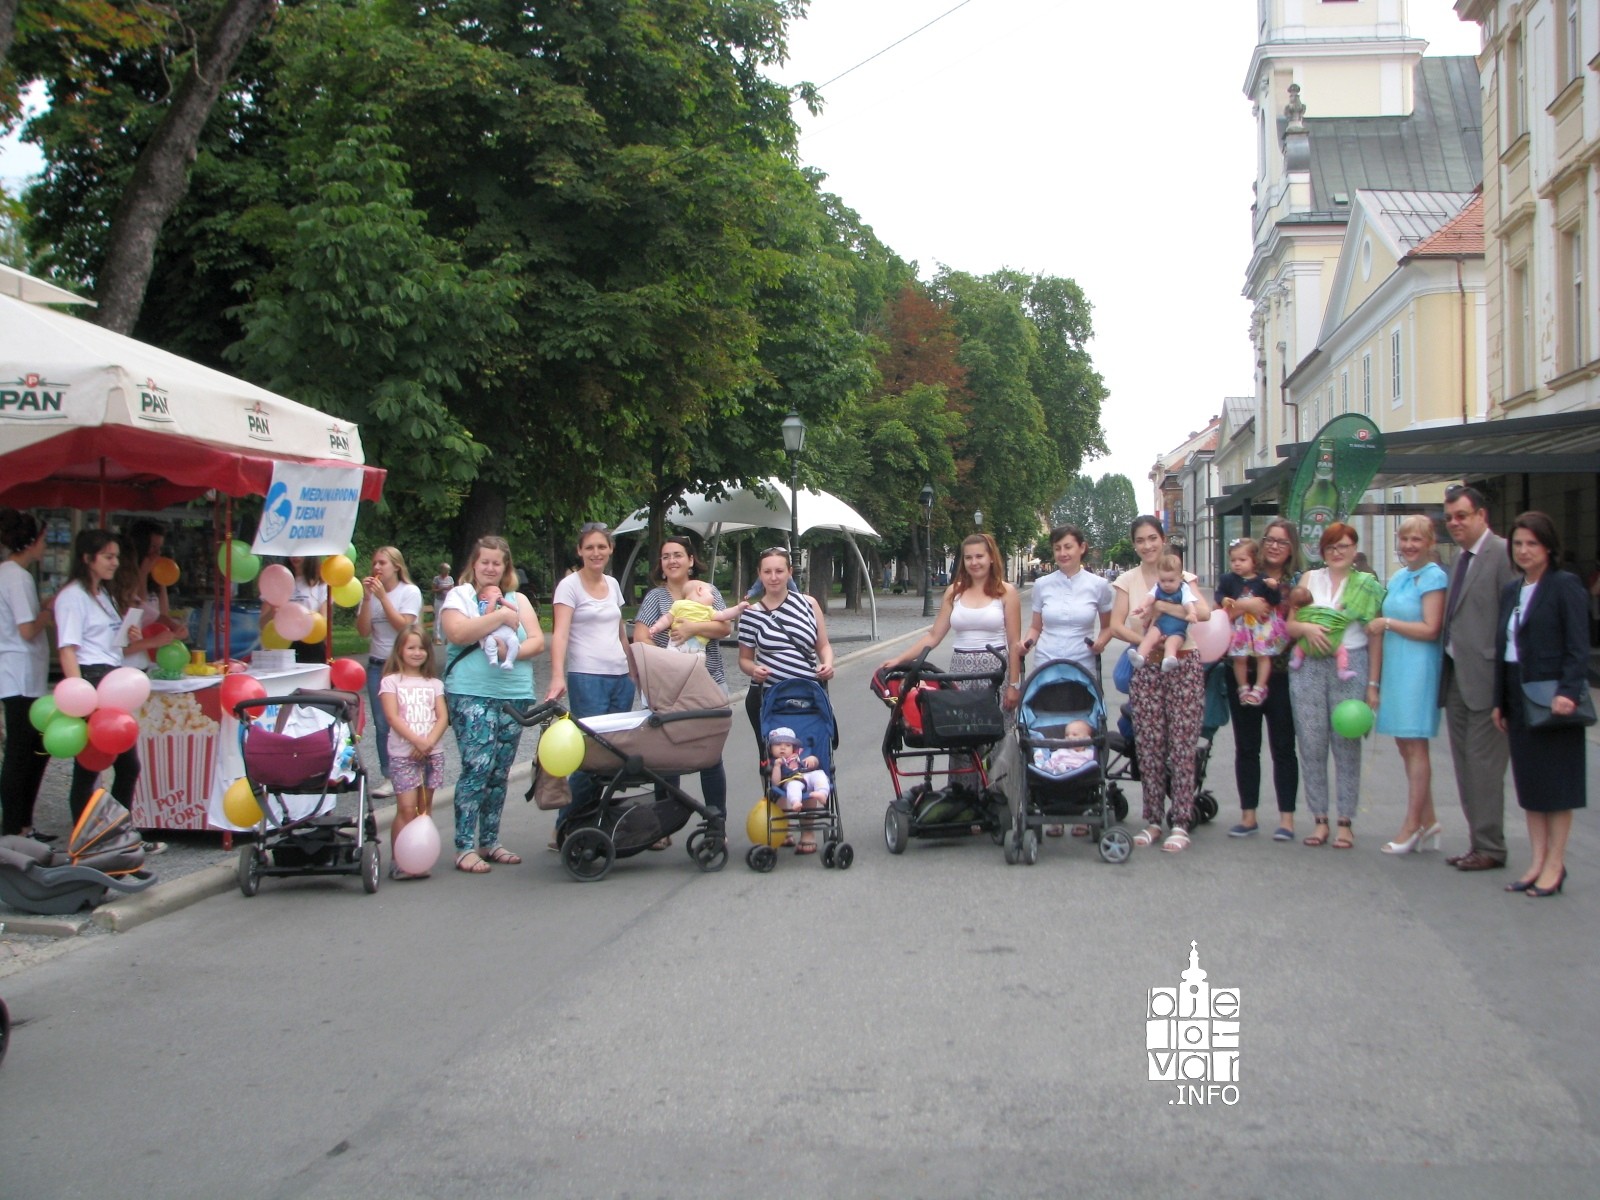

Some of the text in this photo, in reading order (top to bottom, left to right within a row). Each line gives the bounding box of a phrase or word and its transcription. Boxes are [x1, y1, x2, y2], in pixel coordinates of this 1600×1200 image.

[0, 391, 62, 411] PAN
[141, 392, 170, 415] PAN
[248, 415, 270, 435] PAN
[329, 434, 350, 451] PAN
[1301, 524, 1323, 538] PA
[406, 704, 431, 722] AND
[156, 790, 185, 812] POP
[165, 803, 206, 828] CORN
